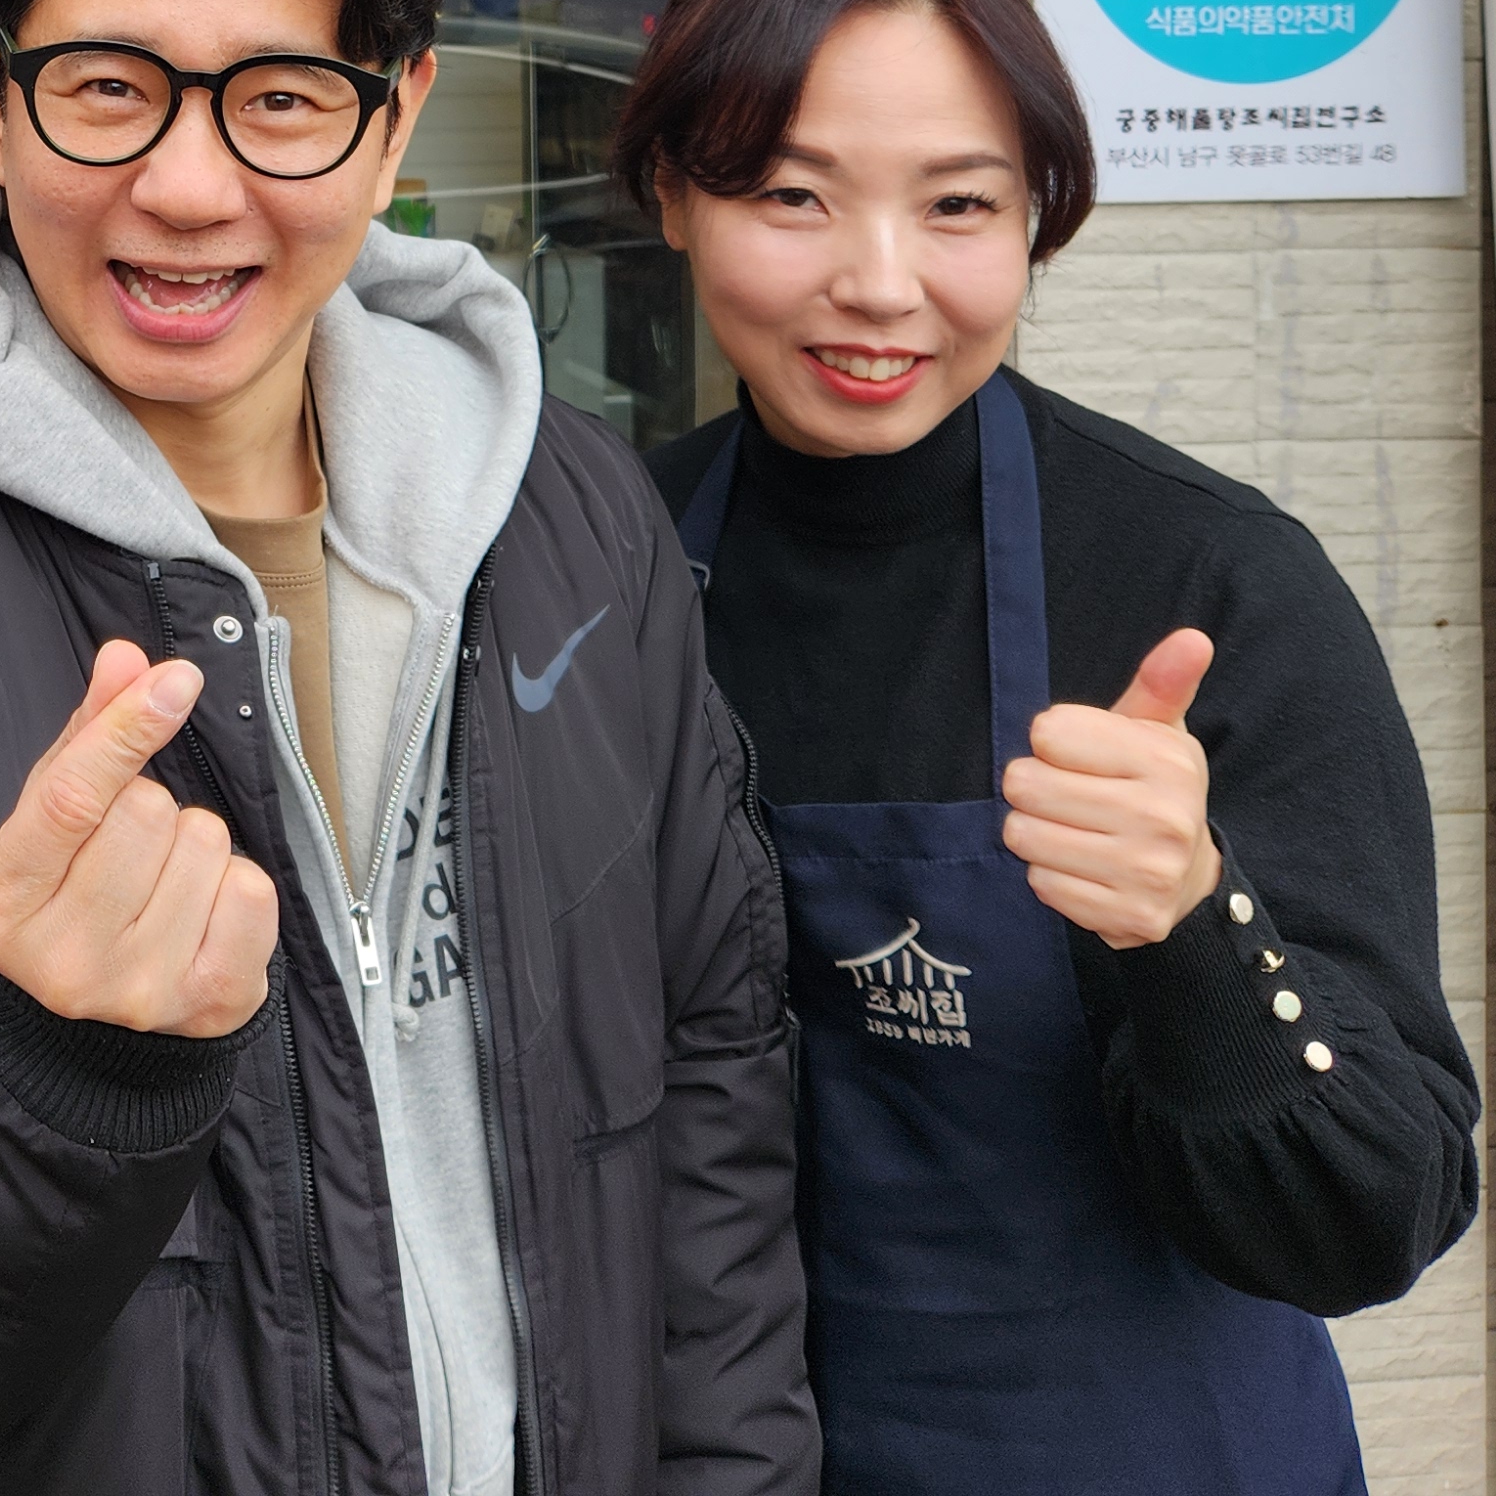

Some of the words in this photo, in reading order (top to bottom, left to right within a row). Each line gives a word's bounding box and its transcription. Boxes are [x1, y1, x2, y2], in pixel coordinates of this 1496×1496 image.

[1145, 5, 1356, 37] 식품의약품안전처
[1106, 146, 1171, 169] 부산시
[1177, 146, 1218, 168] 남구
[866, 985, 967, 1027] 조씨집
